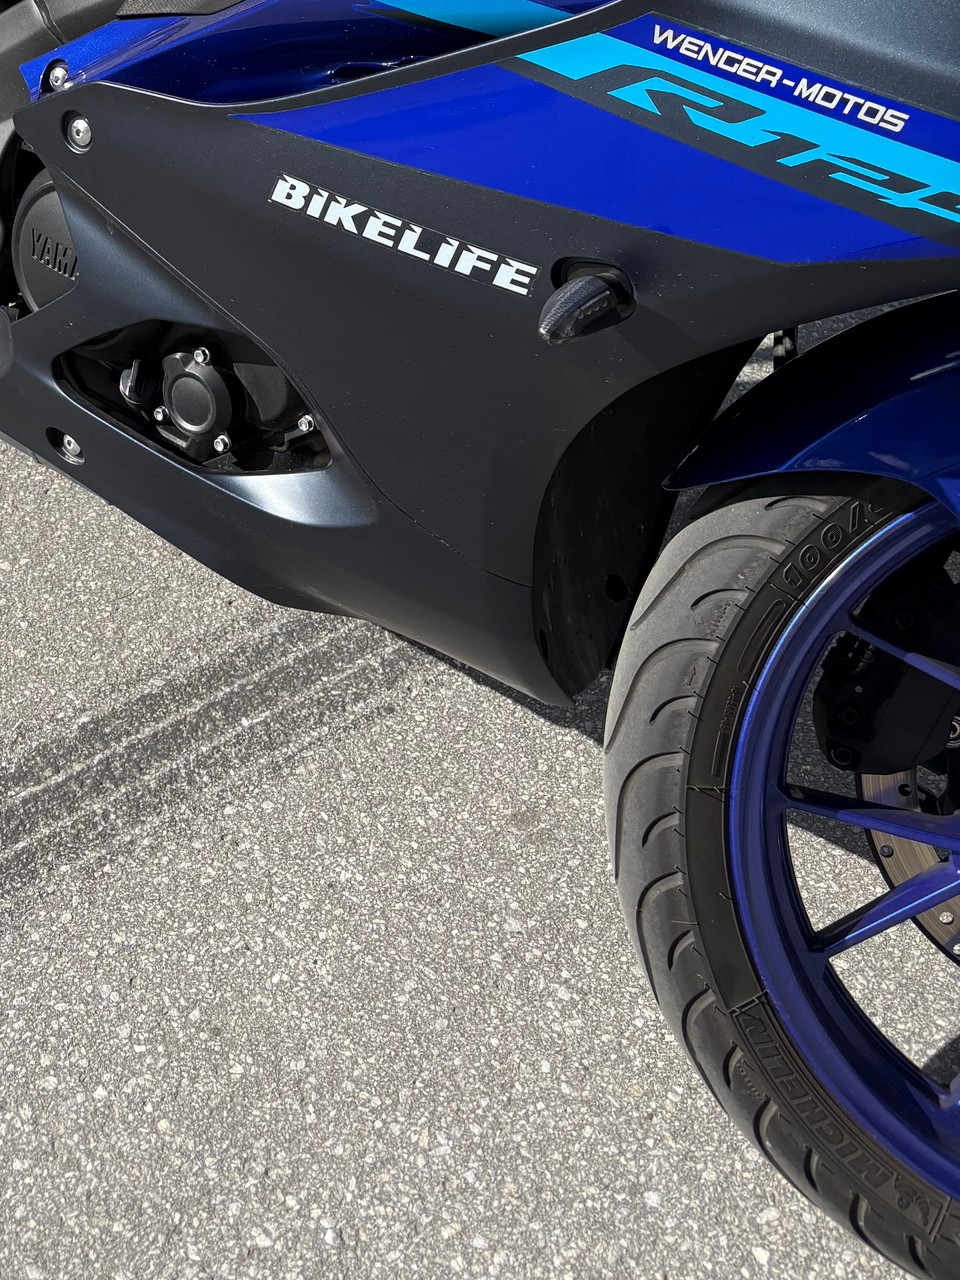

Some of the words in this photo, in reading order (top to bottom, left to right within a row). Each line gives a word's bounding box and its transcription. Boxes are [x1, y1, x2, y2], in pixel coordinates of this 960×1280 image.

[652, 23, 910, 133] WENGER-MOTOS
[271, 174, 538, 296] BIKELIFE
[739, 1008, 892, 1190] MICHELIN
